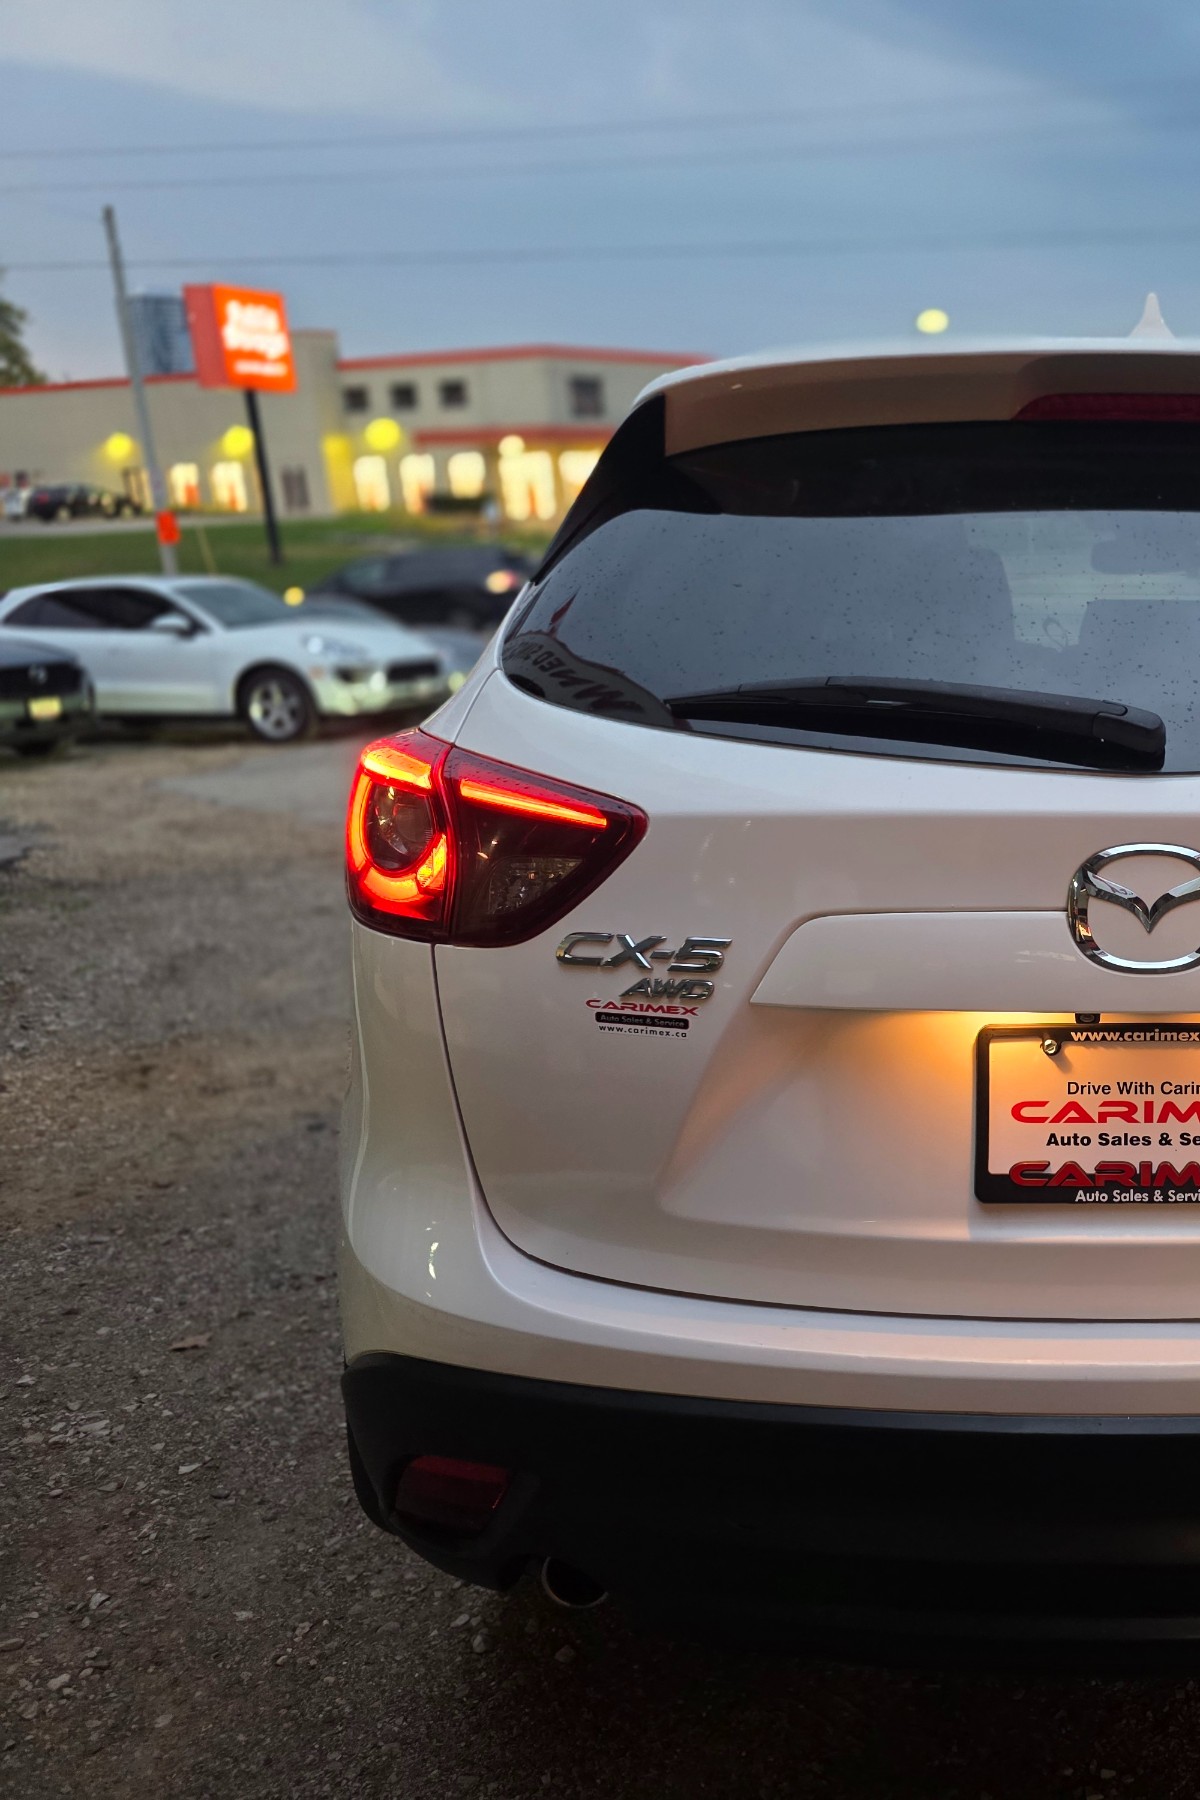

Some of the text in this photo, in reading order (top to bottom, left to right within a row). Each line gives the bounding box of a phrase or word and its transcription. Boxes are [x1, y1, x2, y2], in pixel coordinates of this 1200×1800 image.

[555, 932, 733, 973] CX-5
[619, 977, 714, 1000] AWD
[586, 999, 699, 1016] CARIMEX
[600, 1014, 685, 1027] Auto Sales & Service
[598, 1025, 687, 1038] www.carimex.ca
[1067, 1081, 1112, 1095] Drive
[1117, 1081, 1155, 1095] With
[1046, 1133, 1092, 1147] Auto
[1098, 1132, 1152, 1147] Sales
[1158, 1132, 1173, 1146] &
[1075, 1189, 1109, 1203] Auto
[1112, 1189, 1149, 1203] Sales
[1153, 1189, 1164, 1203] &
